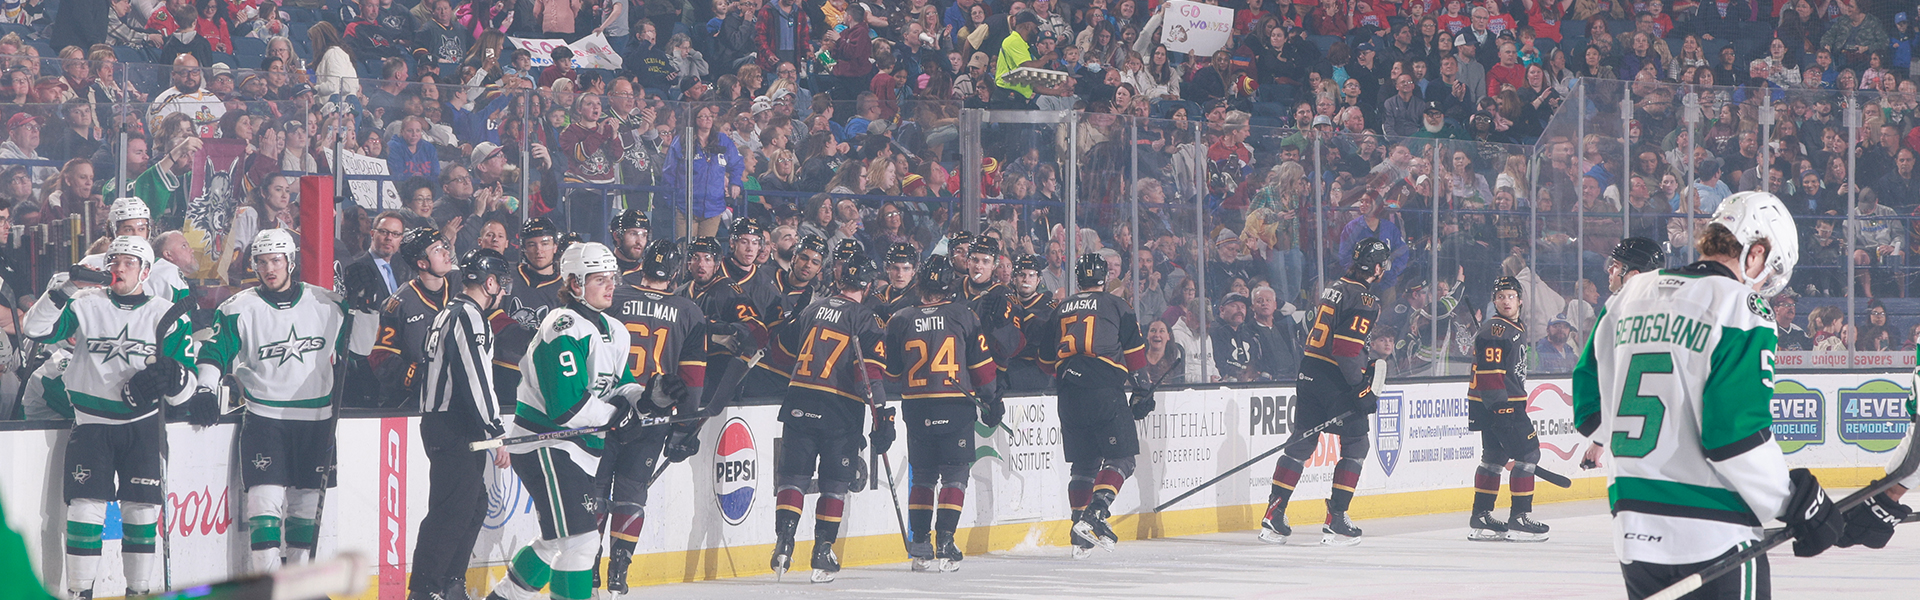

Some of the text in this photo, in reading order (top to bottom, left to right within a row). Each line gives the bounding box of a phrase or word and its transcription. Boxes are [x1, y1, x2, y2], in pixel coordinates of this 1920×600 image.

[1180, 5, 1200, 18] GO
[1189, 20, 1230, 33] WOLVES
[1658, 279, 1686, 287] CCM
[622, 300, 678, 323] STILLMAN
[736, 304, 758, 318] 21
[815, 306, 842, 324] RYAN
[1061, 299, 1098, 314] JAASKA
[914, 316, 944, 333] SMITH
[1350, 316, 1371, 334] 15
[1615, 313, 1711, 353] BERGSLAND
[86, 331, 157, 361] TEXAS
[259, 329, 326, 364] TEXAS
[1057, 315, 1096, 359] 51
[797, 326, 850, 379] 47
[904, 336, 960, 388] 24
[1485, 347, 1503, 363] 93
[1811, 351, 1847, 366] unique
[1854, 353, 1893, 366] savers
[558, 350, 578, 377] 9
[1760, 348, 1775, 389] 5
[1610, 352, 1674, 458] 5
[1135, 411, 1226, 439] WHITEHALL
[1303, 417, 1338, 438] CCM
[1036, 426, 1043, 446] &
[1152, 448, 1211, 464] OF DEERFIELD
[130, 476, 160, 487] CCM
[716, 459, 756, 484] PEPSI
[1161, 476, 1203, 489] HEALTHCARE
[387, 428, 400, 570] CCM
[1624, 532, 1663, 543] CCM
